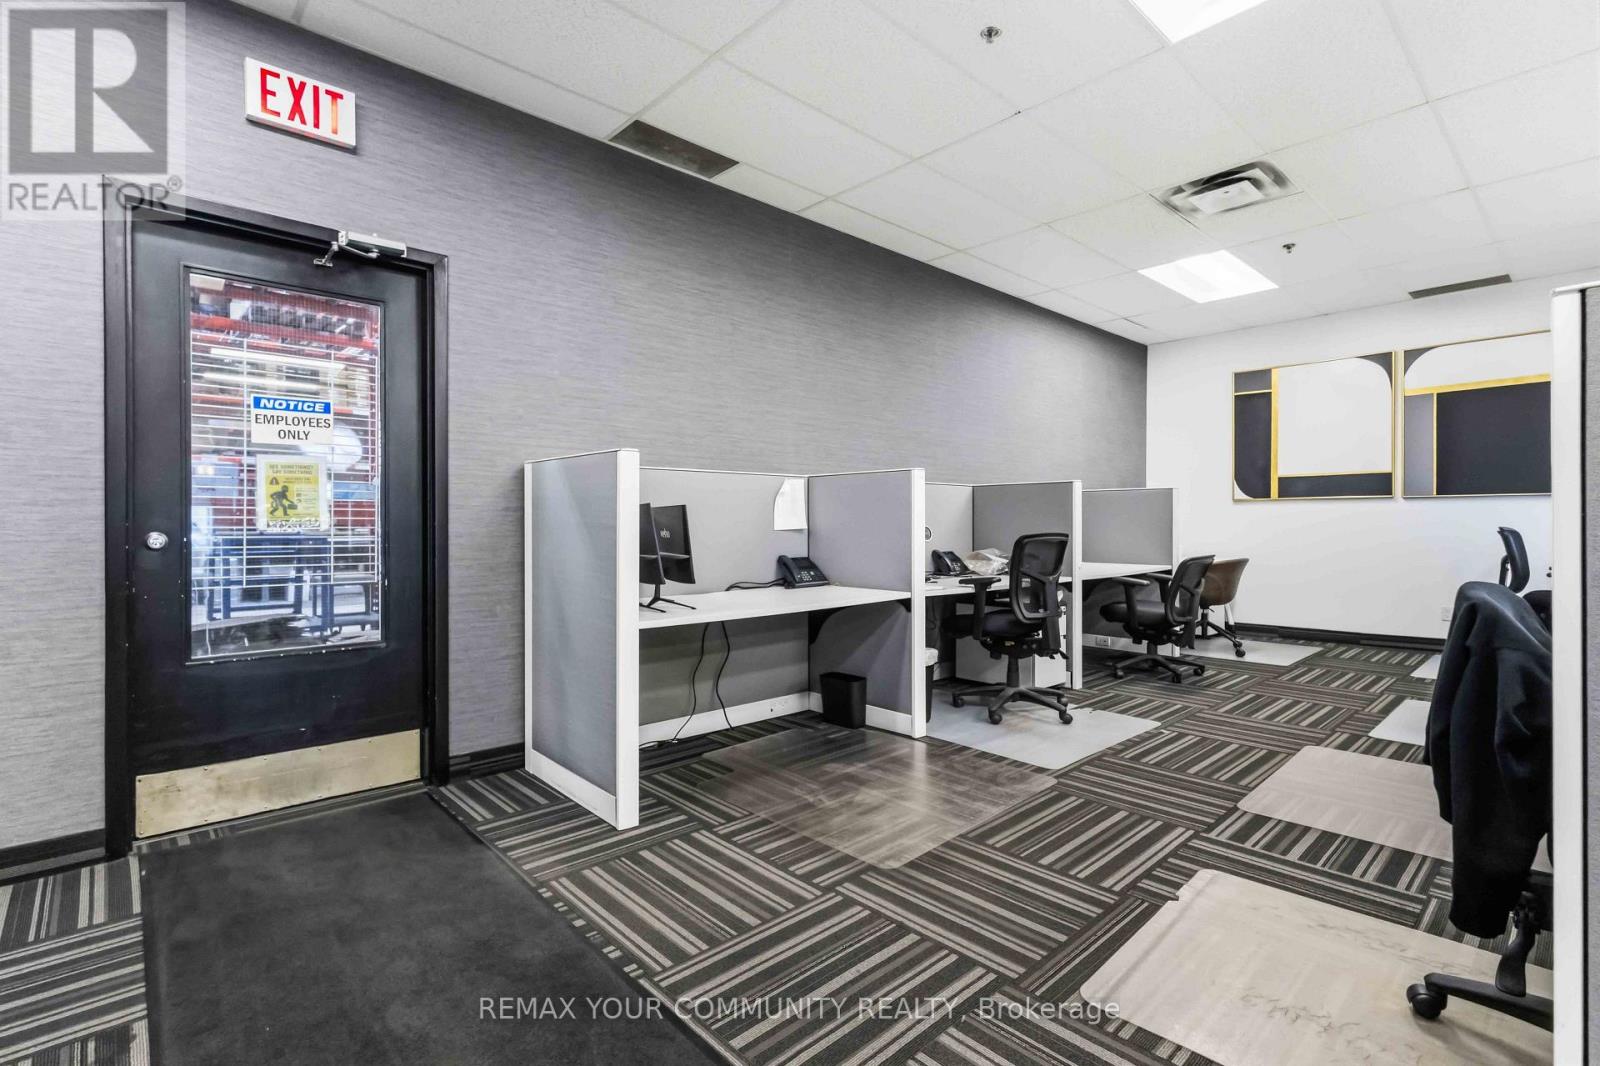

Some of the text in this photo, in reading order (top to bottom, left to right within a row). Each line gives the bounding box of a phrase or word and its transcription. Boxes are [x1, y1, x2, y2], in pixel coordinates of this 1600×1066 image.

[259, 67, 344, 136] EXIT
[259, 398, 326, 413] NOTICE
[254, 413, 332, 429] EMPLOYEES
[277, 429, 311, 441] ONLY
